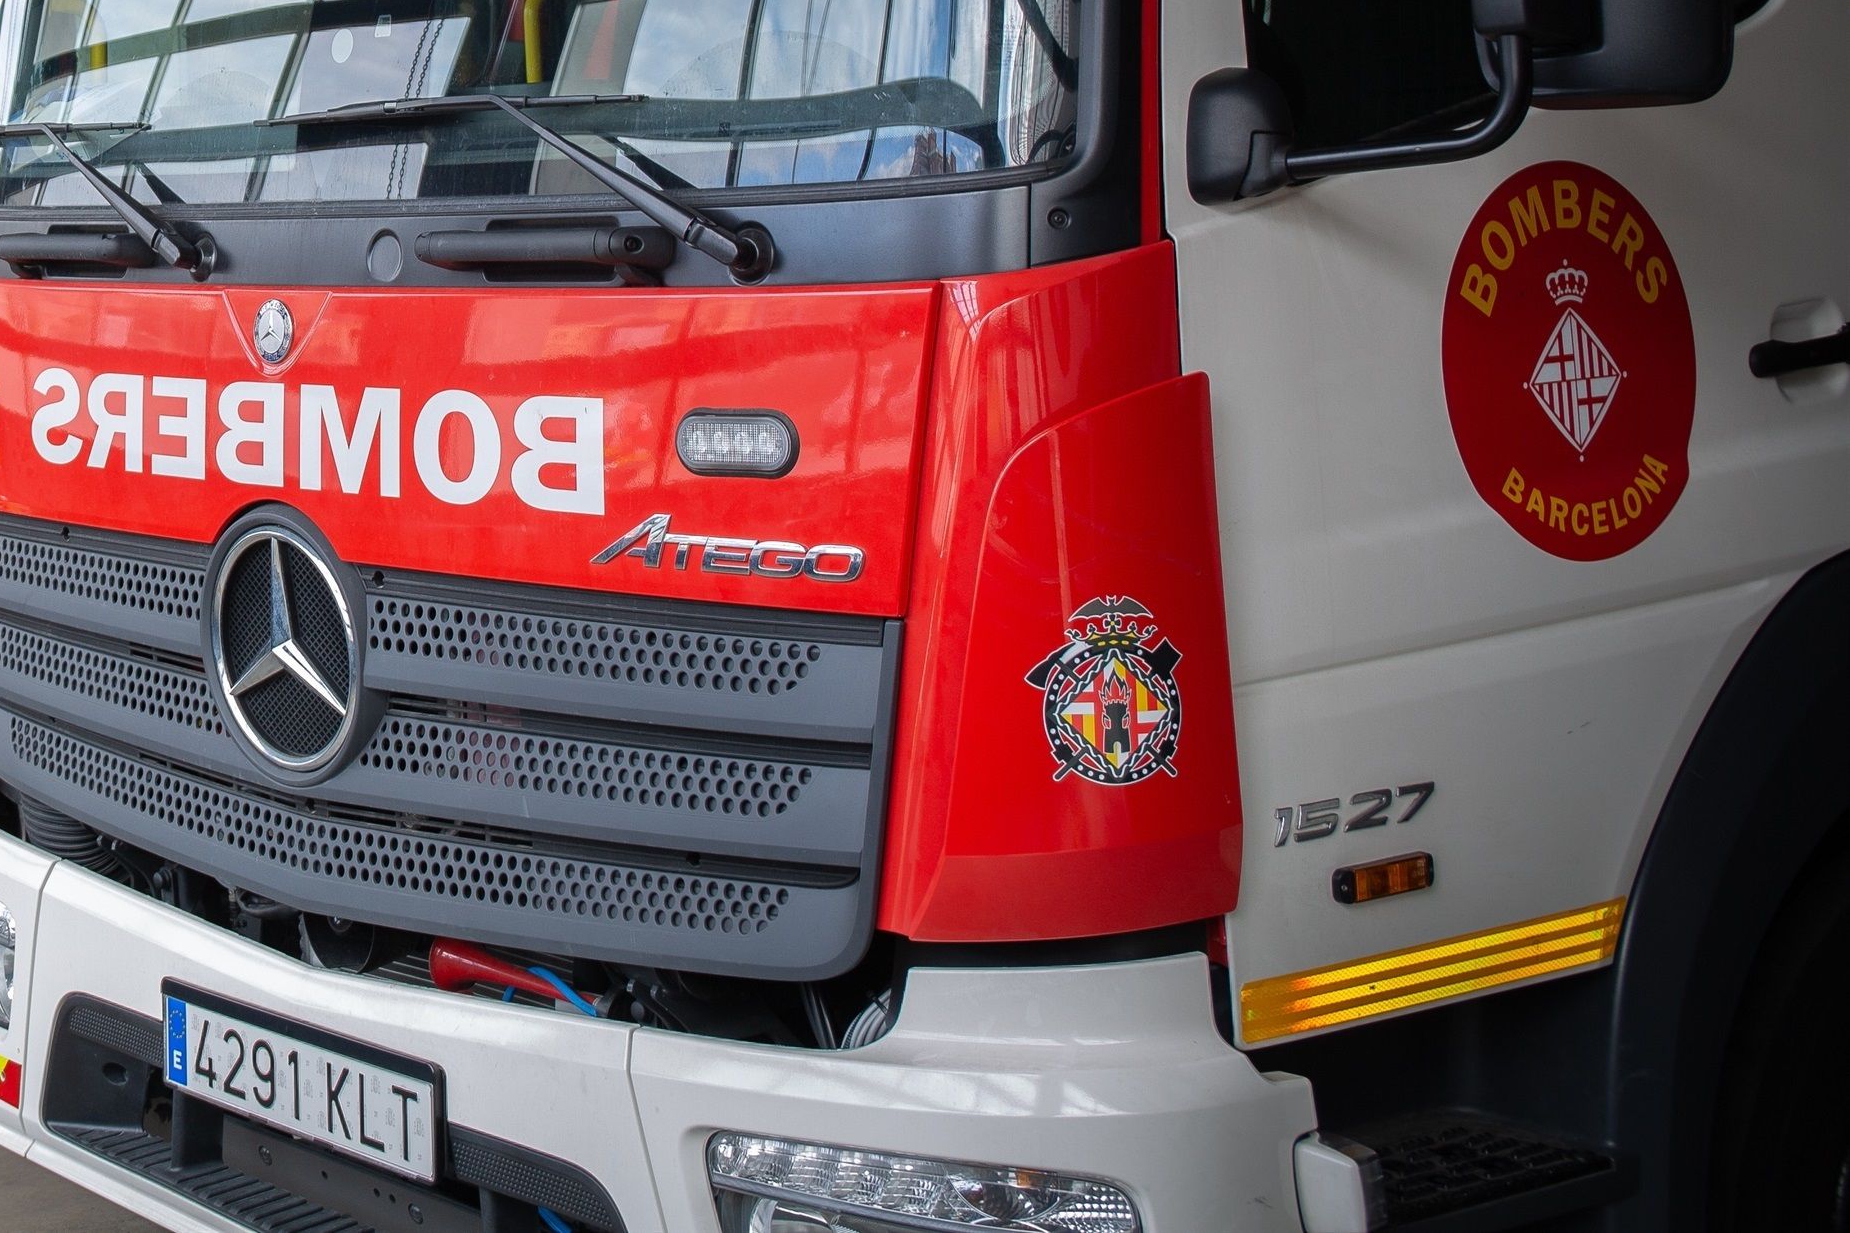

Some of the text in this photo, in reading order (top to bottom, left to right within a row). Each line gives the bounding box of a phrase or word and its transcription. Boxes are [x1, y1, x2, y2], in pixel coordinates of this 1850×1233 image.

[1460, 179, 1668, 317] BOMBERS
[1502, 454, 1668, 535] BARCELONA
[590, 513, 865, 582] ATEGO
[1274, 781, 1435, 847] 1527
[172, 1049, 183, 1071] E
[194, 1019, 419, 1162] 4291 KLT
